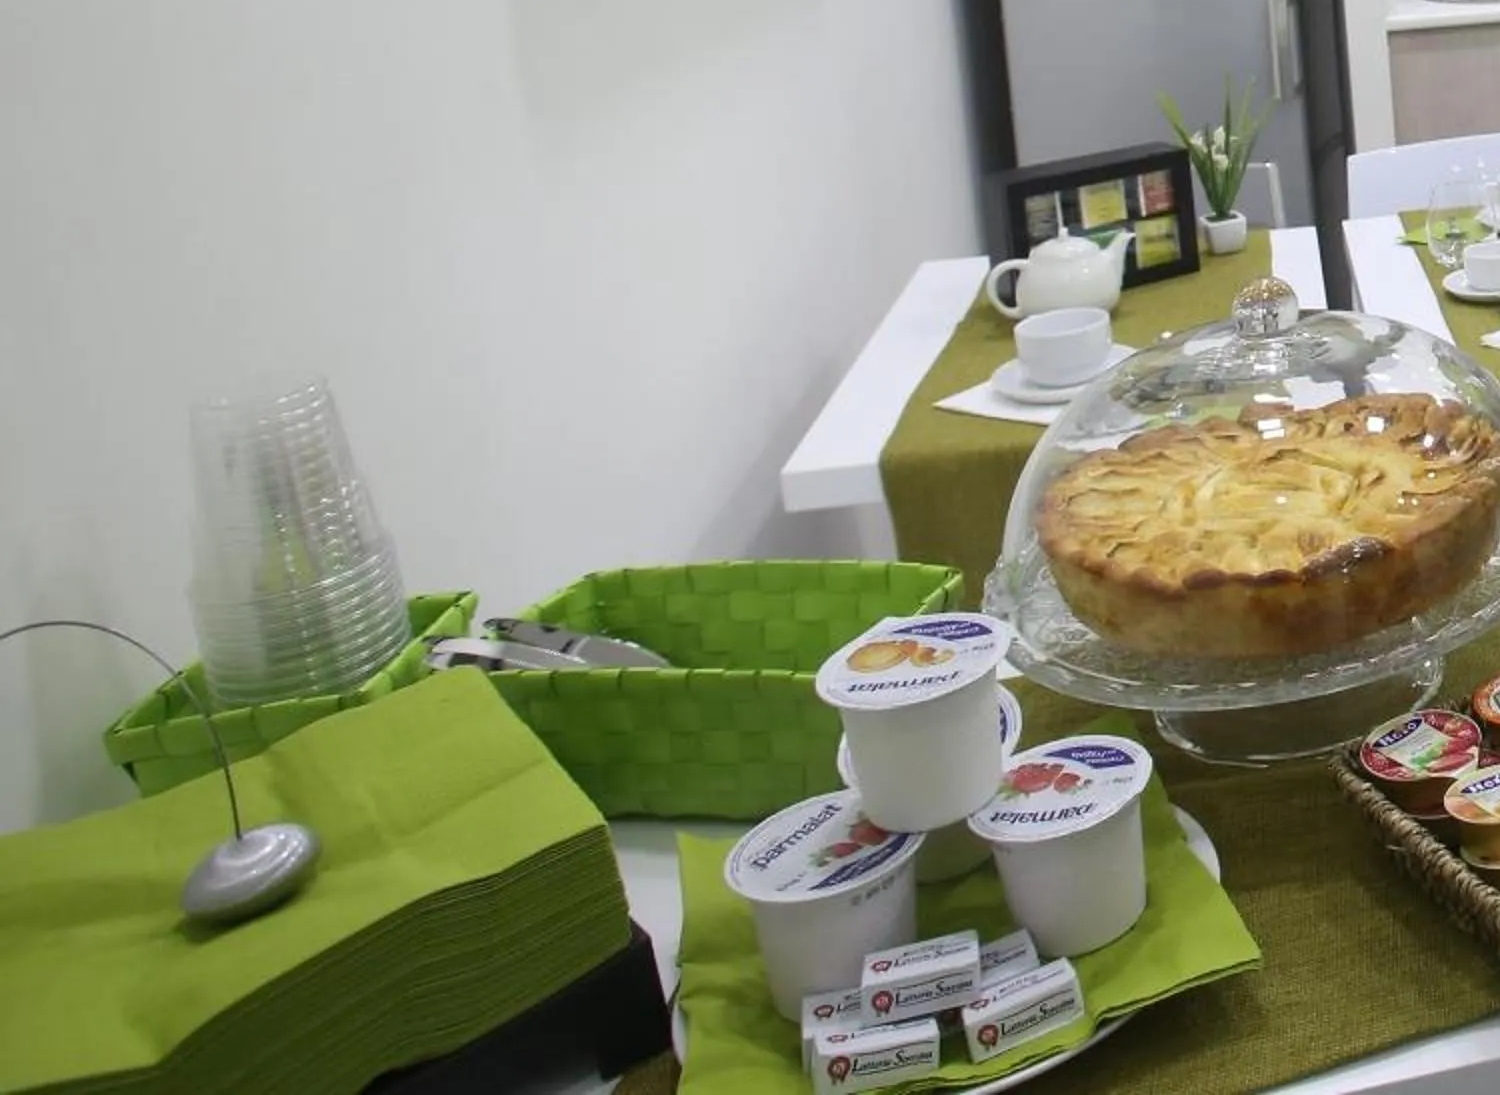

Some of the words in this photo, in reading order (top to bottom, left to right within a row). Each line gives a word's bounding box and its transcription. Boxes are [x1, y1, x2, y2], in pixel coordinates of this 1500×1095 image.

[847, 670, 960, 693] parmalat
[990, 802, 1098, 826] parmalat
[752, 803, 843, 871] parmalat
